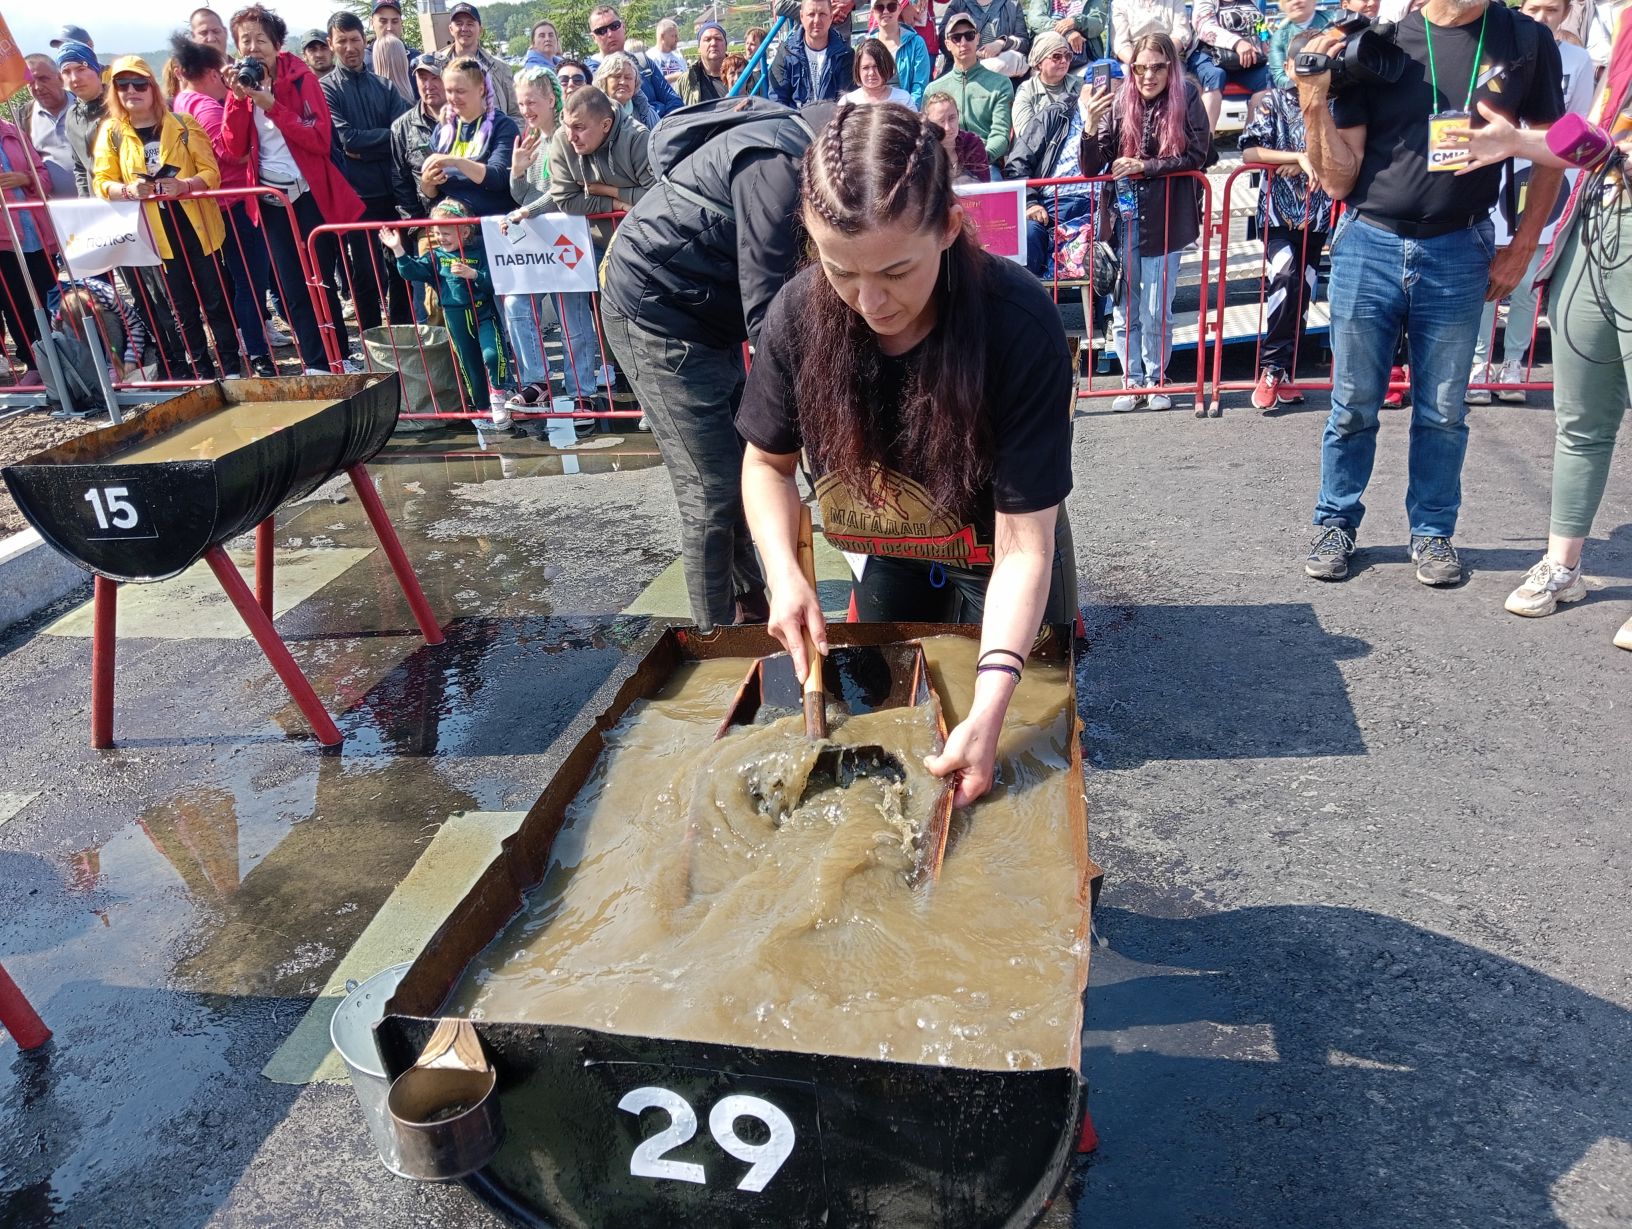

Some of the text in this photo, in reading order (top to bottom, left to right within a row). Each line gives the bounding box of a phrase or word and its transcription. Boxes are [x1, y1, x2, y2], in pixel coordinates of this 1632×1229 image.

[495, 253, 557, 266] ПАВЛИК
[84, 487, 138, 529] 15
[830, 507, 927, 536] МАГАДАН
[618, 1087, 795, 1192] 29
